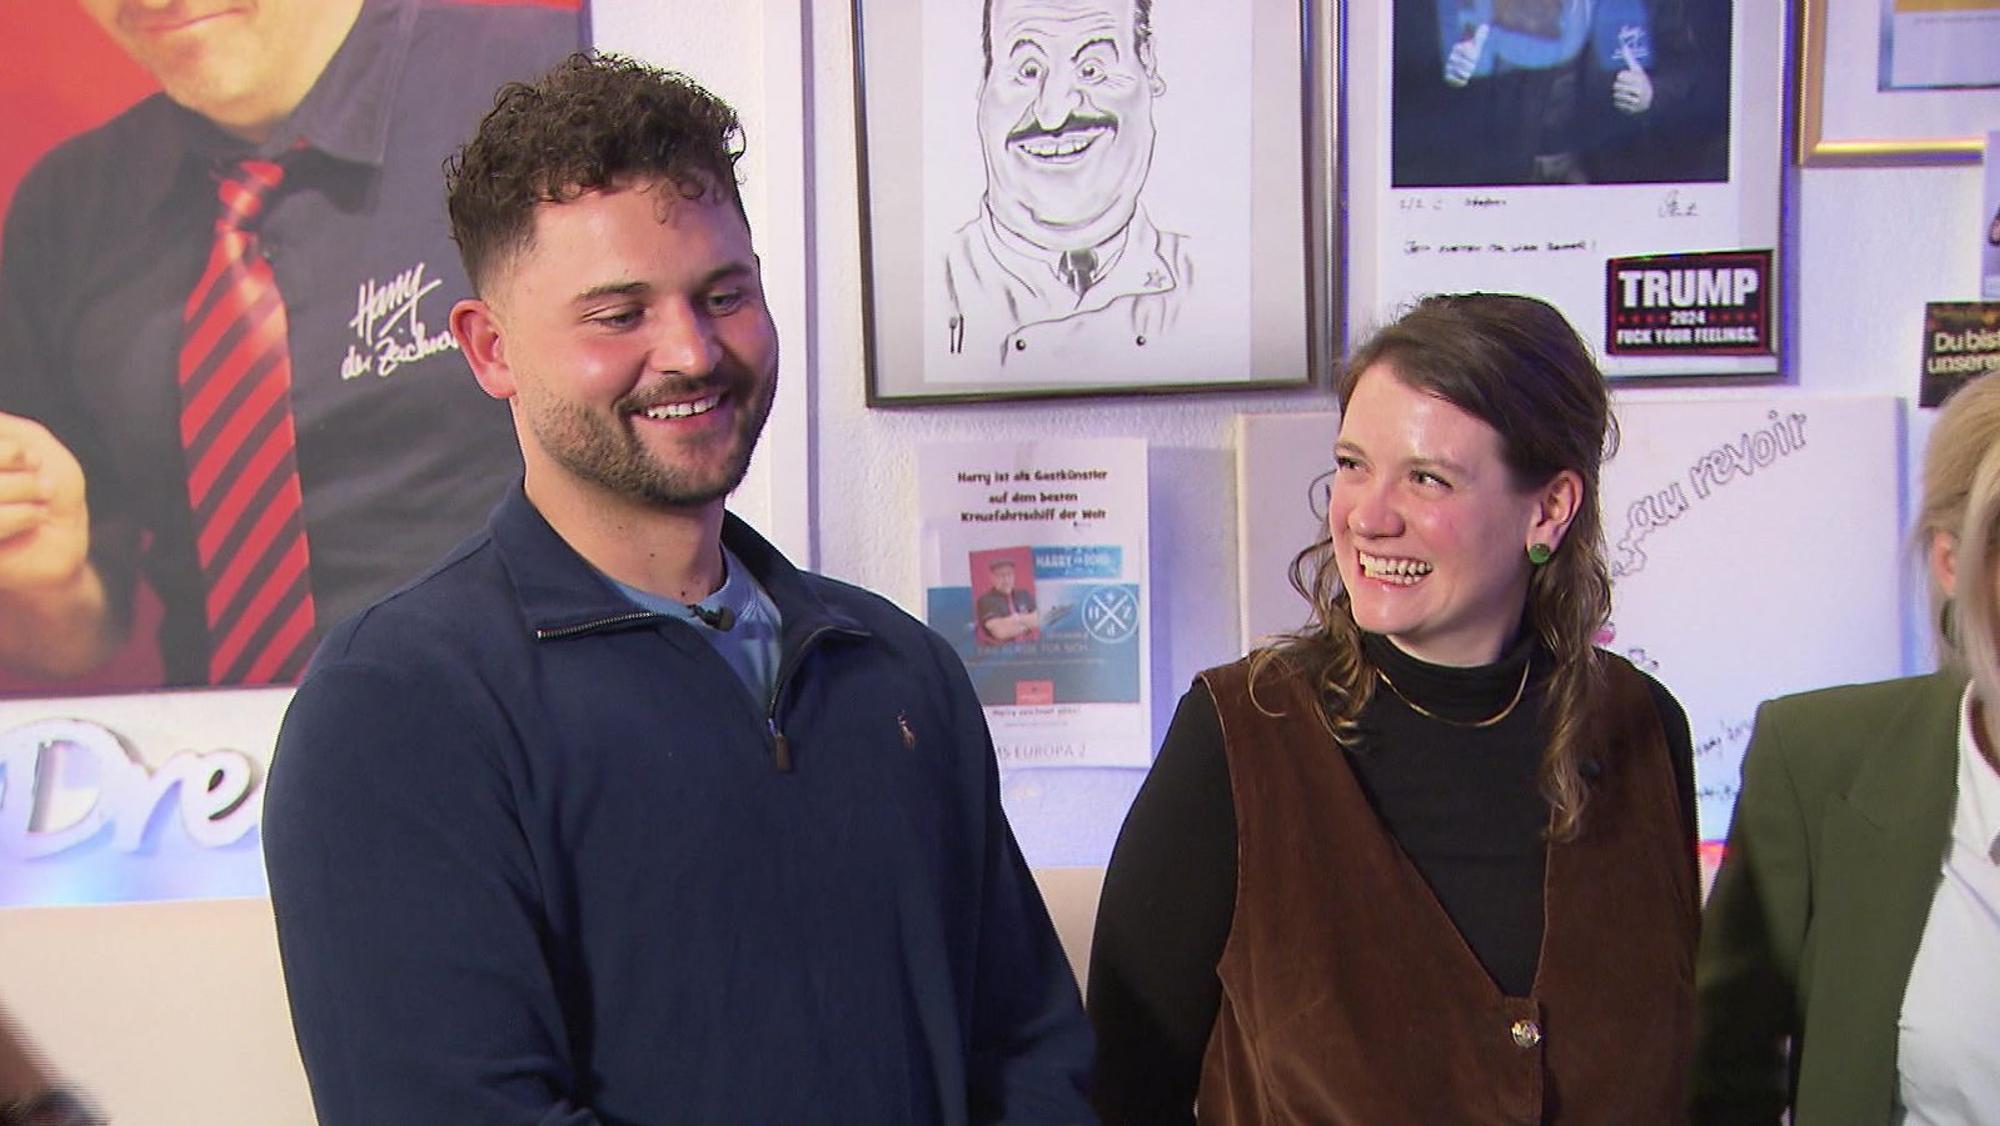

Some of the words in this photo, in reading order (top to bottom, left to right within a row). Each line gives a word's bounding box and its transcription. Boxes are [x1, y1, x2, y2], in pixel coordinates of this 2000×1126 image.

[1618, 268, 1760, 307] TRUMP
[350, 262, 443, 346] Harry
[1670, 310, 1706, 325] 2024
[1616, 329, 1652, 344] FUCK
[1654, 328, 1692, 343] YOUR
[1935, 332, 1964, 352] Du
[1690, 410, 1807, 499] revoir
[958, 472, 991, 485] Harry
[995, 471, 1009, 482] ist
[1014, 470, 1030, 481] als
[1035, 469, 1108, 481] Gastkünstler
[989, 492, 1007, 503] auf
[1012, 492, 1036, 502] dem
[1040, 491, 1078, 502] besten
[961, 508, 1055, 522] Kreuzfahrtschiff
[1059, 508, 1076, 520] der
[1082, 507, 1106, 519] Welt
[1014, 744, 1074, 760] EUROPA
